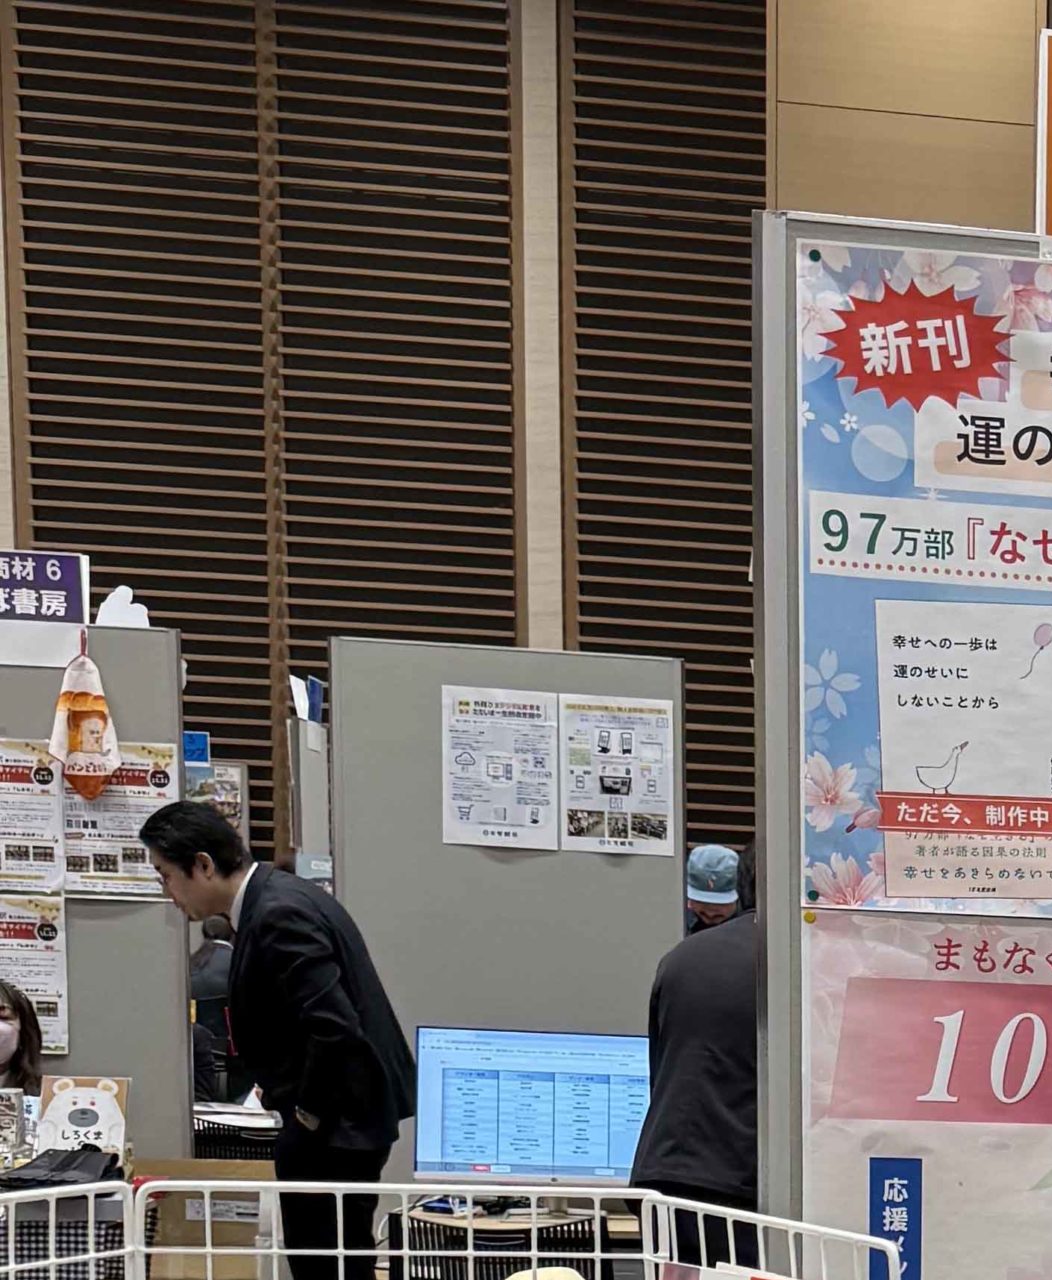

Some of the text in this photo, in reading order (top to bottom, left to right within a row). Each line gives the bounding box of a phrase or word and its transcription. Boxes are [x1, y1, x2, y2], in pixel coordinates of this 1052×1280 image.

[860, 314, 972, 377] 新刊
[46, 560, 61, 581] 6
[893, 636, 998, 650] 幸せへの一歩は
[894, 664, 968, 679] 運のせいに
[898, 694, 999, 709] しないことから
[914, 846, 1047, 858] 著者が語る因果の法則
[61, 1130, 103, 1140] しろくま
